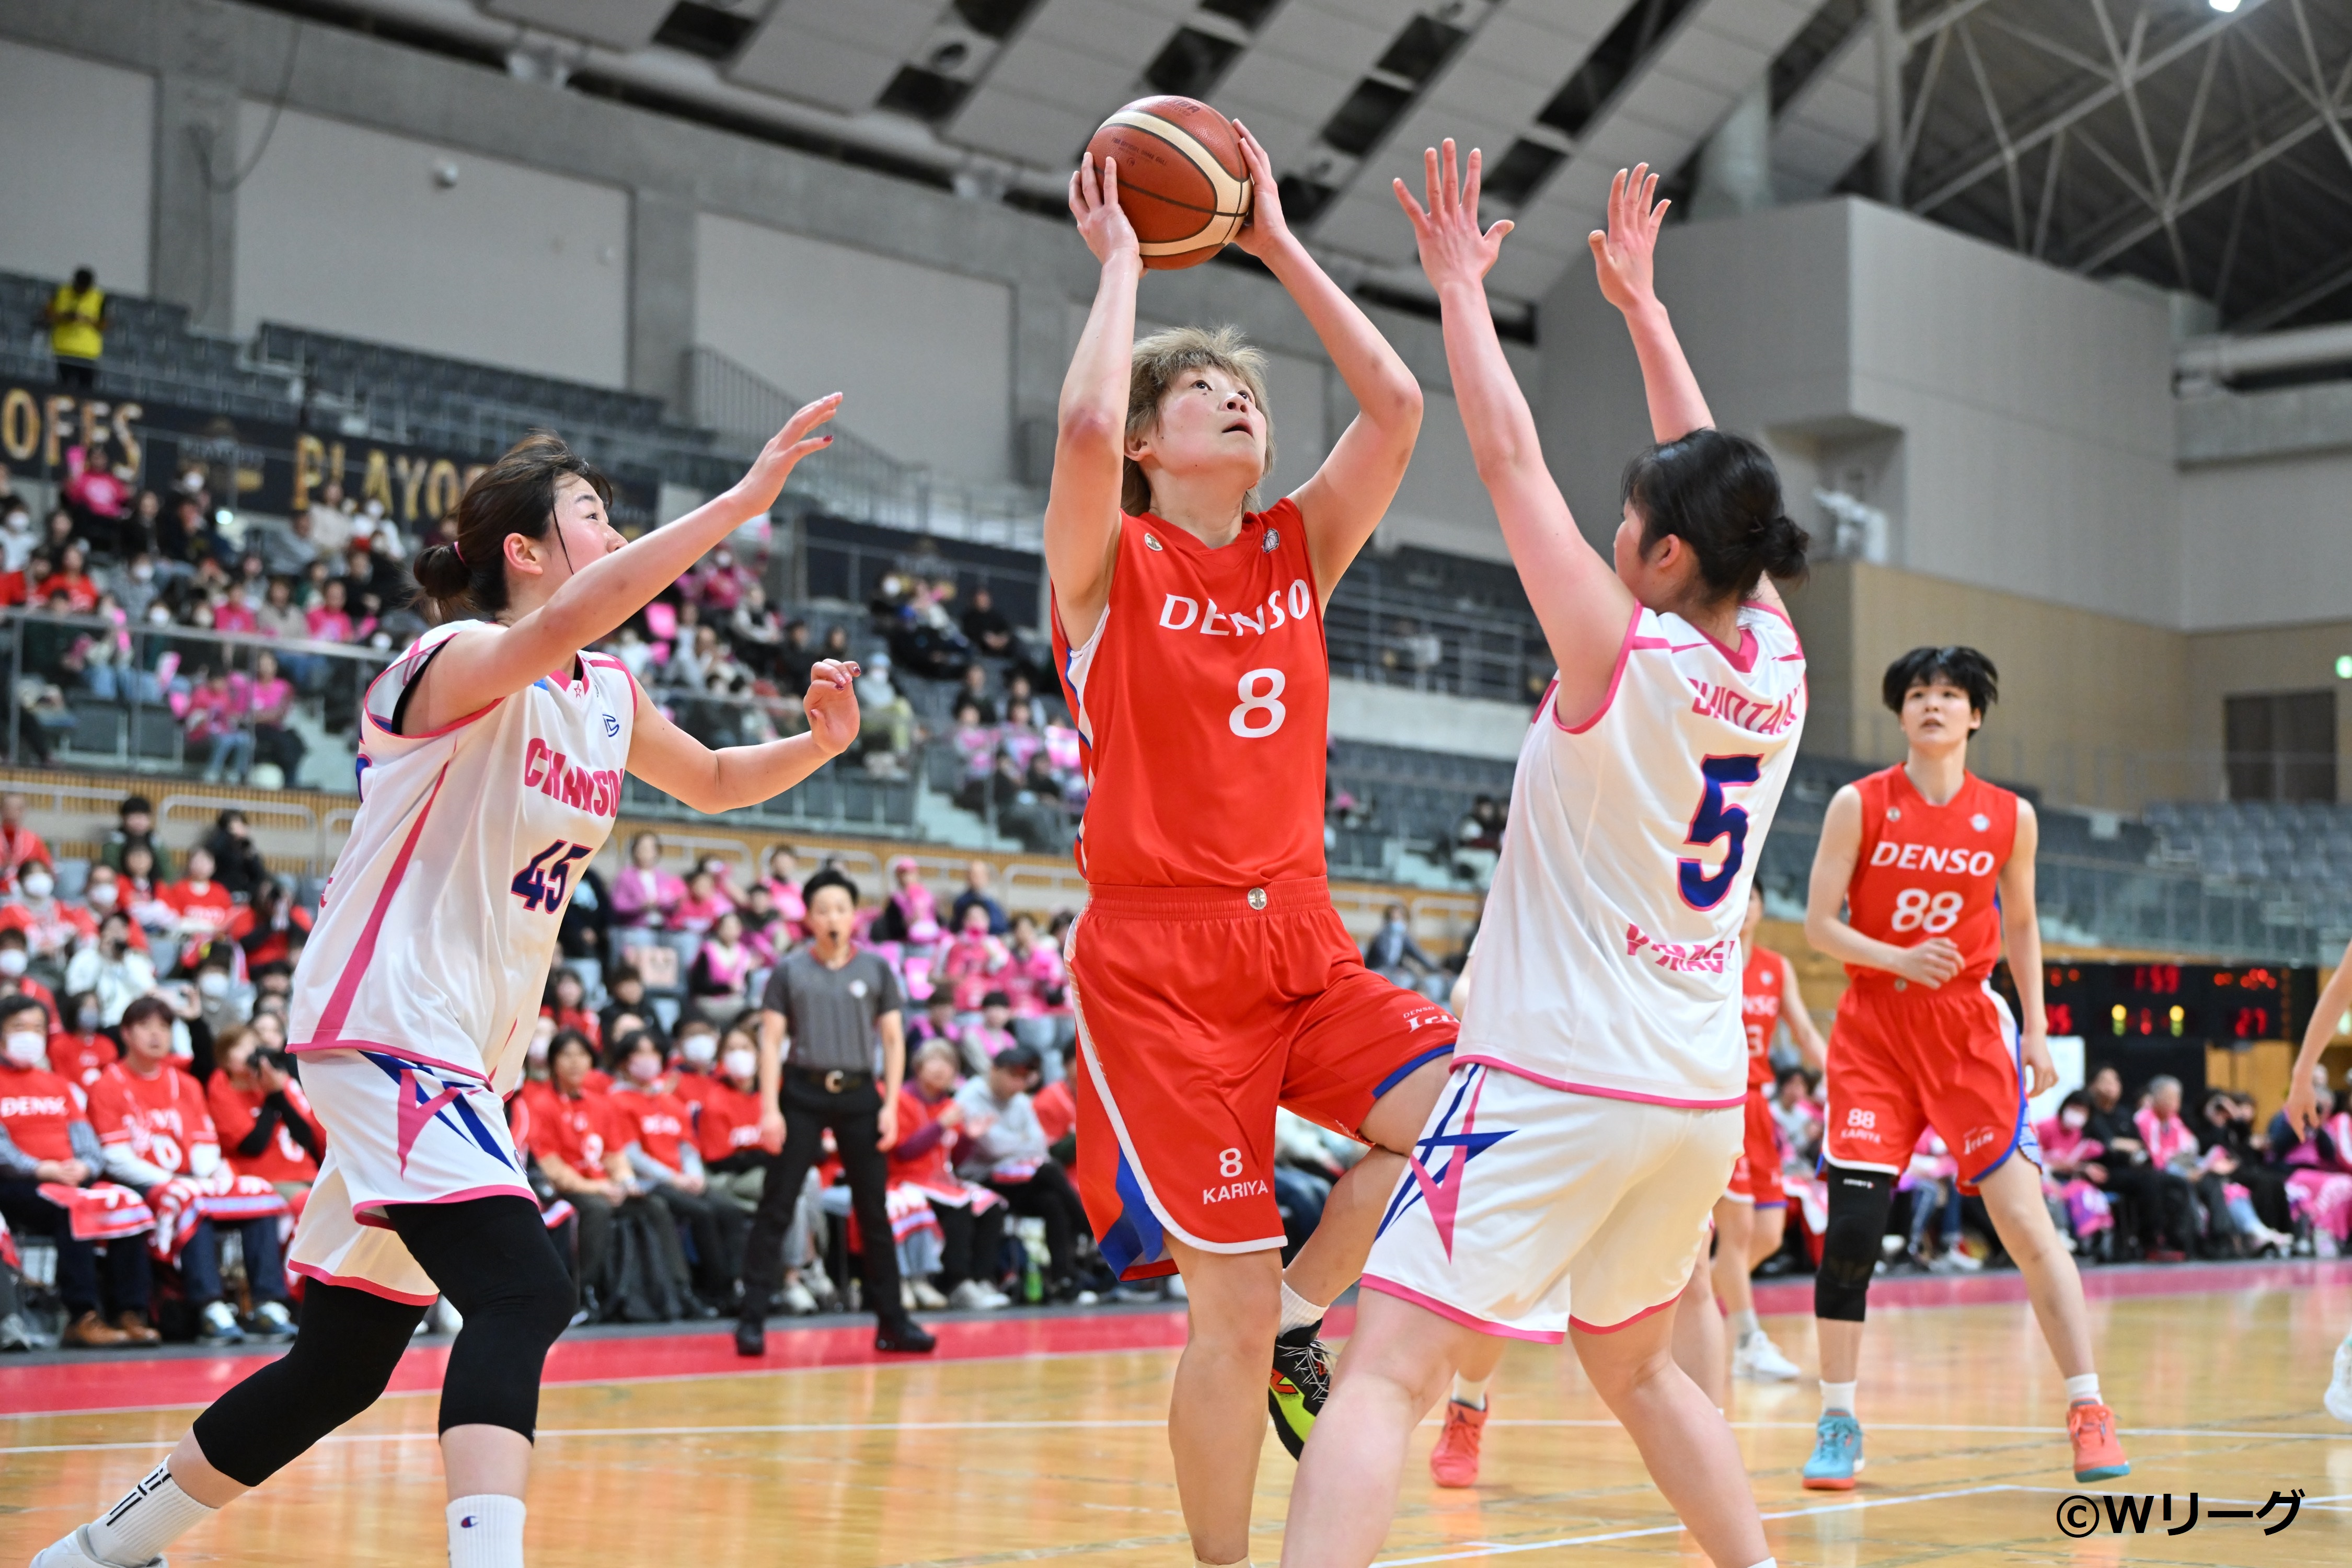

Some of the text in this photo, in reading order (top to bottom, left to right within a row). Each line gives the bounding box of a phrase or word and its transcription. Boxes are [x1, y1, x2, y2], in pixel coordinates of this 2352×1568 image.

[1159, 579, 1310, 637] DENSO
[1229, 668, 1286, 738] 8
[524, 737, 624, 818] CHANSO
[1676, 753, 1765, 912] 5
[511, 839, 594, 915] 45
[1870, 840, 1994, 877] DENSO
[1891, 887, 1964, 933] 88
[1403, 1006, 1435, 1019] DENSO
[1406, 1015, 1461, 1033] Iri
[1847, 1108, 1875, 1129] 88
[1219, 1148, 1243, 1178] 8
[1203, 1179, 1269, 1205] KARIYA
